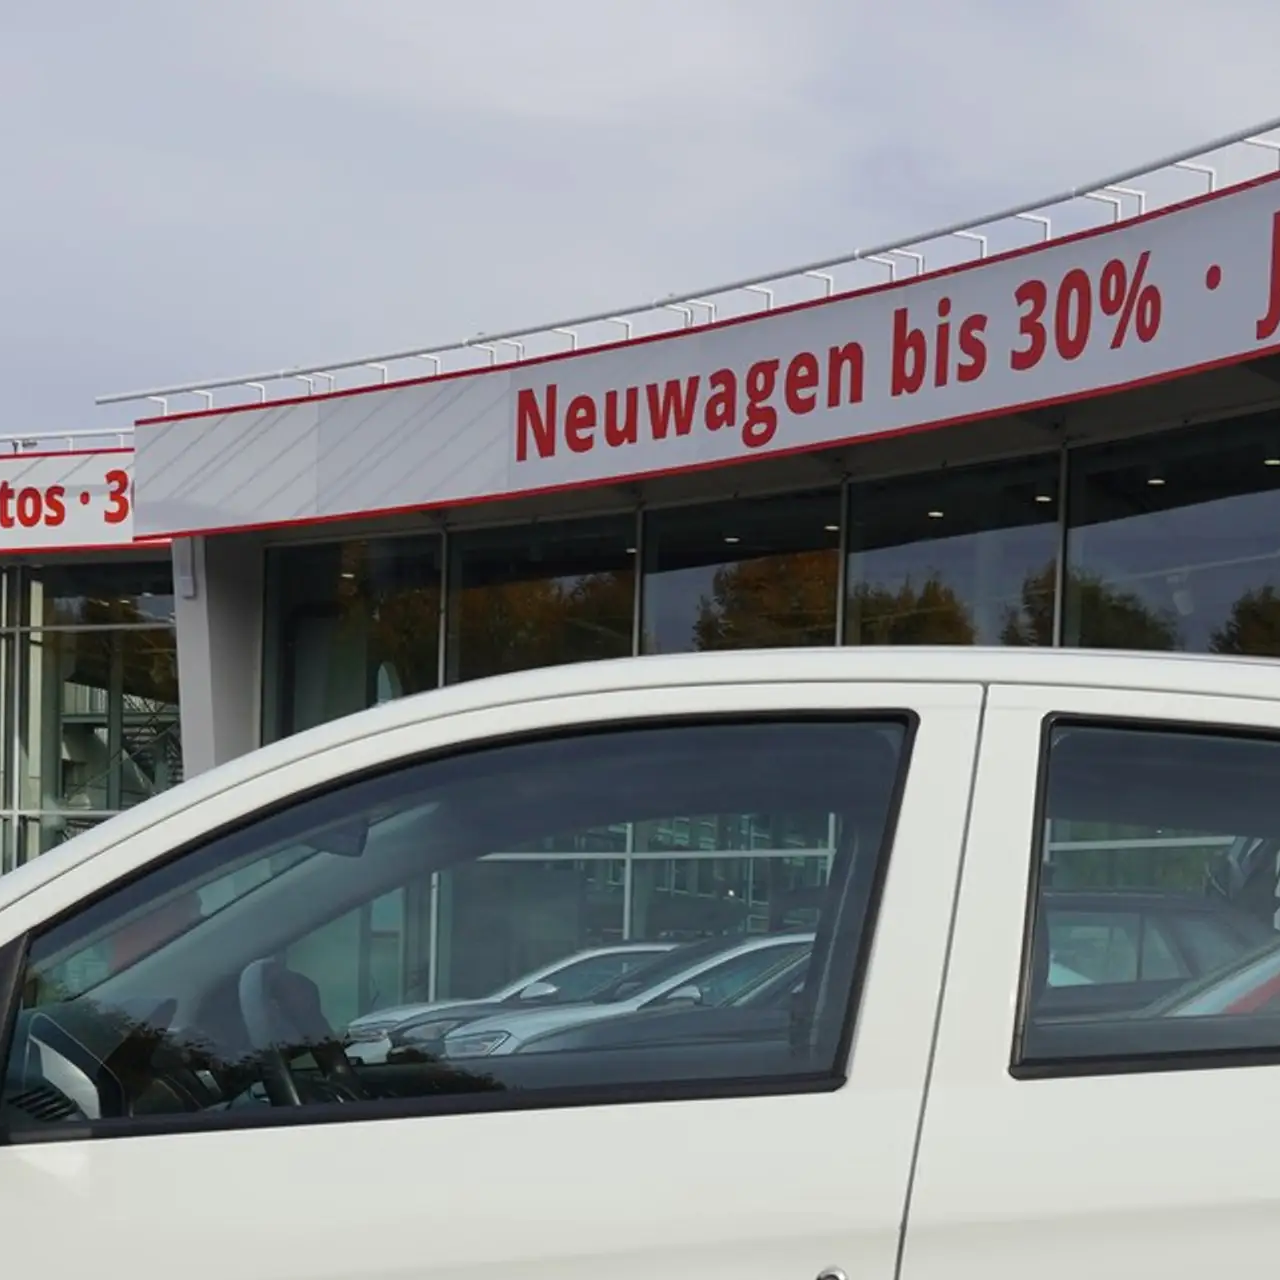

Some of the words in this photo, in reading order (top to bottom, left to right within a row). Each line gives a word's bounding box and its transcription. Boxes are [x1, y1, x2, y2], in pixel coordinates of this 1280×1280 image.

[516, 341, 864, 462] Neuwagen
[891, 297, 988, 396] bis
[1010, 250, 1162, 371] 30%
[104, 469, 135, 525] 3
